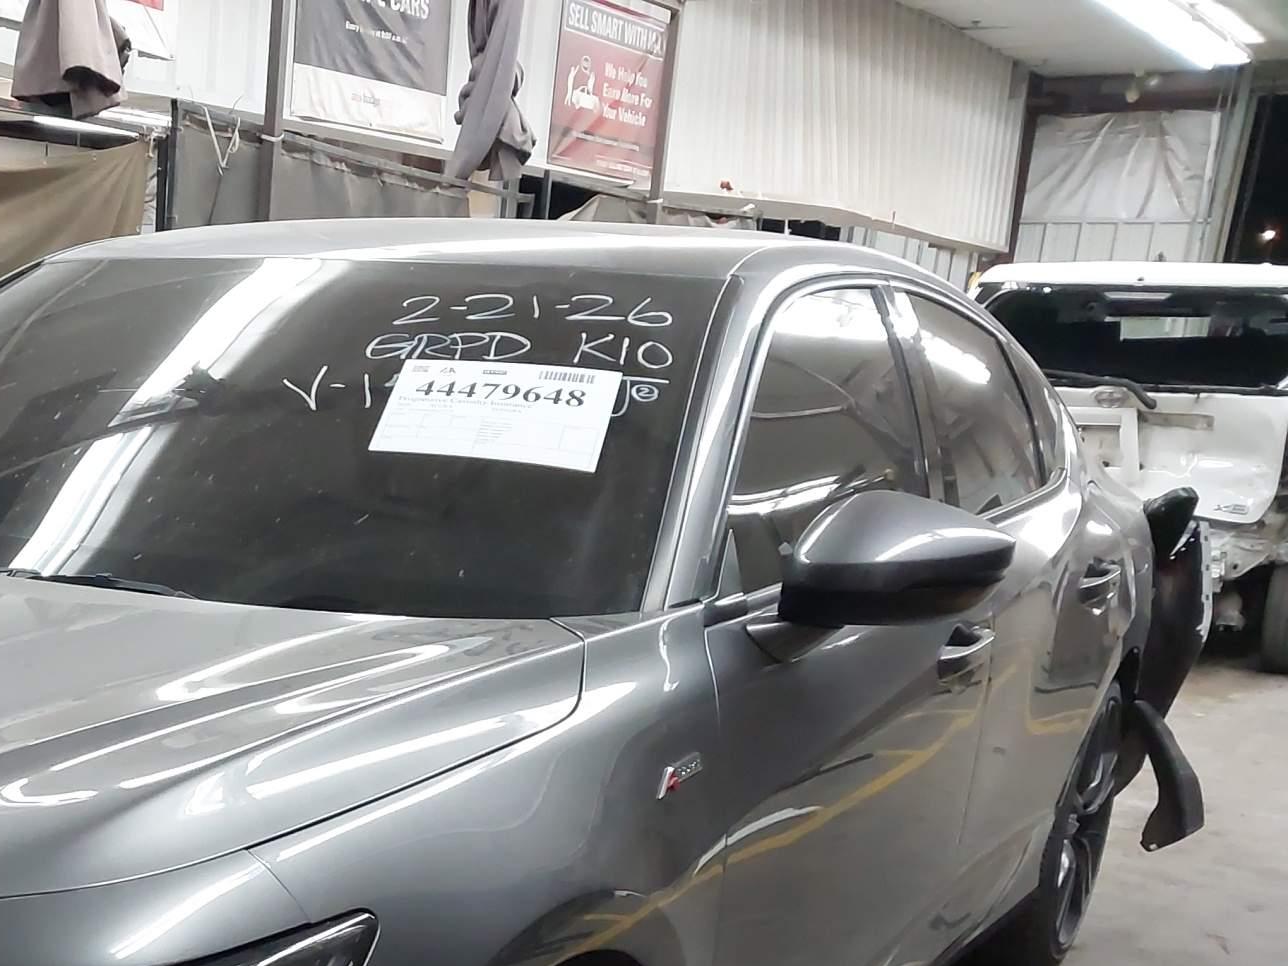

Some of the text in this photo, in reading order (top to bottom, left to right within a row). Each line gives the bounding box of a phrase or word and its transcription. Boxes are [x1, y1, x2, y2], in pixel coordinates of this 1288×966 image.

[568, 2, 589, 30] SELL
[591, 10, 624, 41] SMART
[624, 21, 648, 50] WITH
[618, 106, 646, 127] Vehicle
[392, 294, 673, 327] 2-21-26
[415, 379, 587, 408] 44479648
